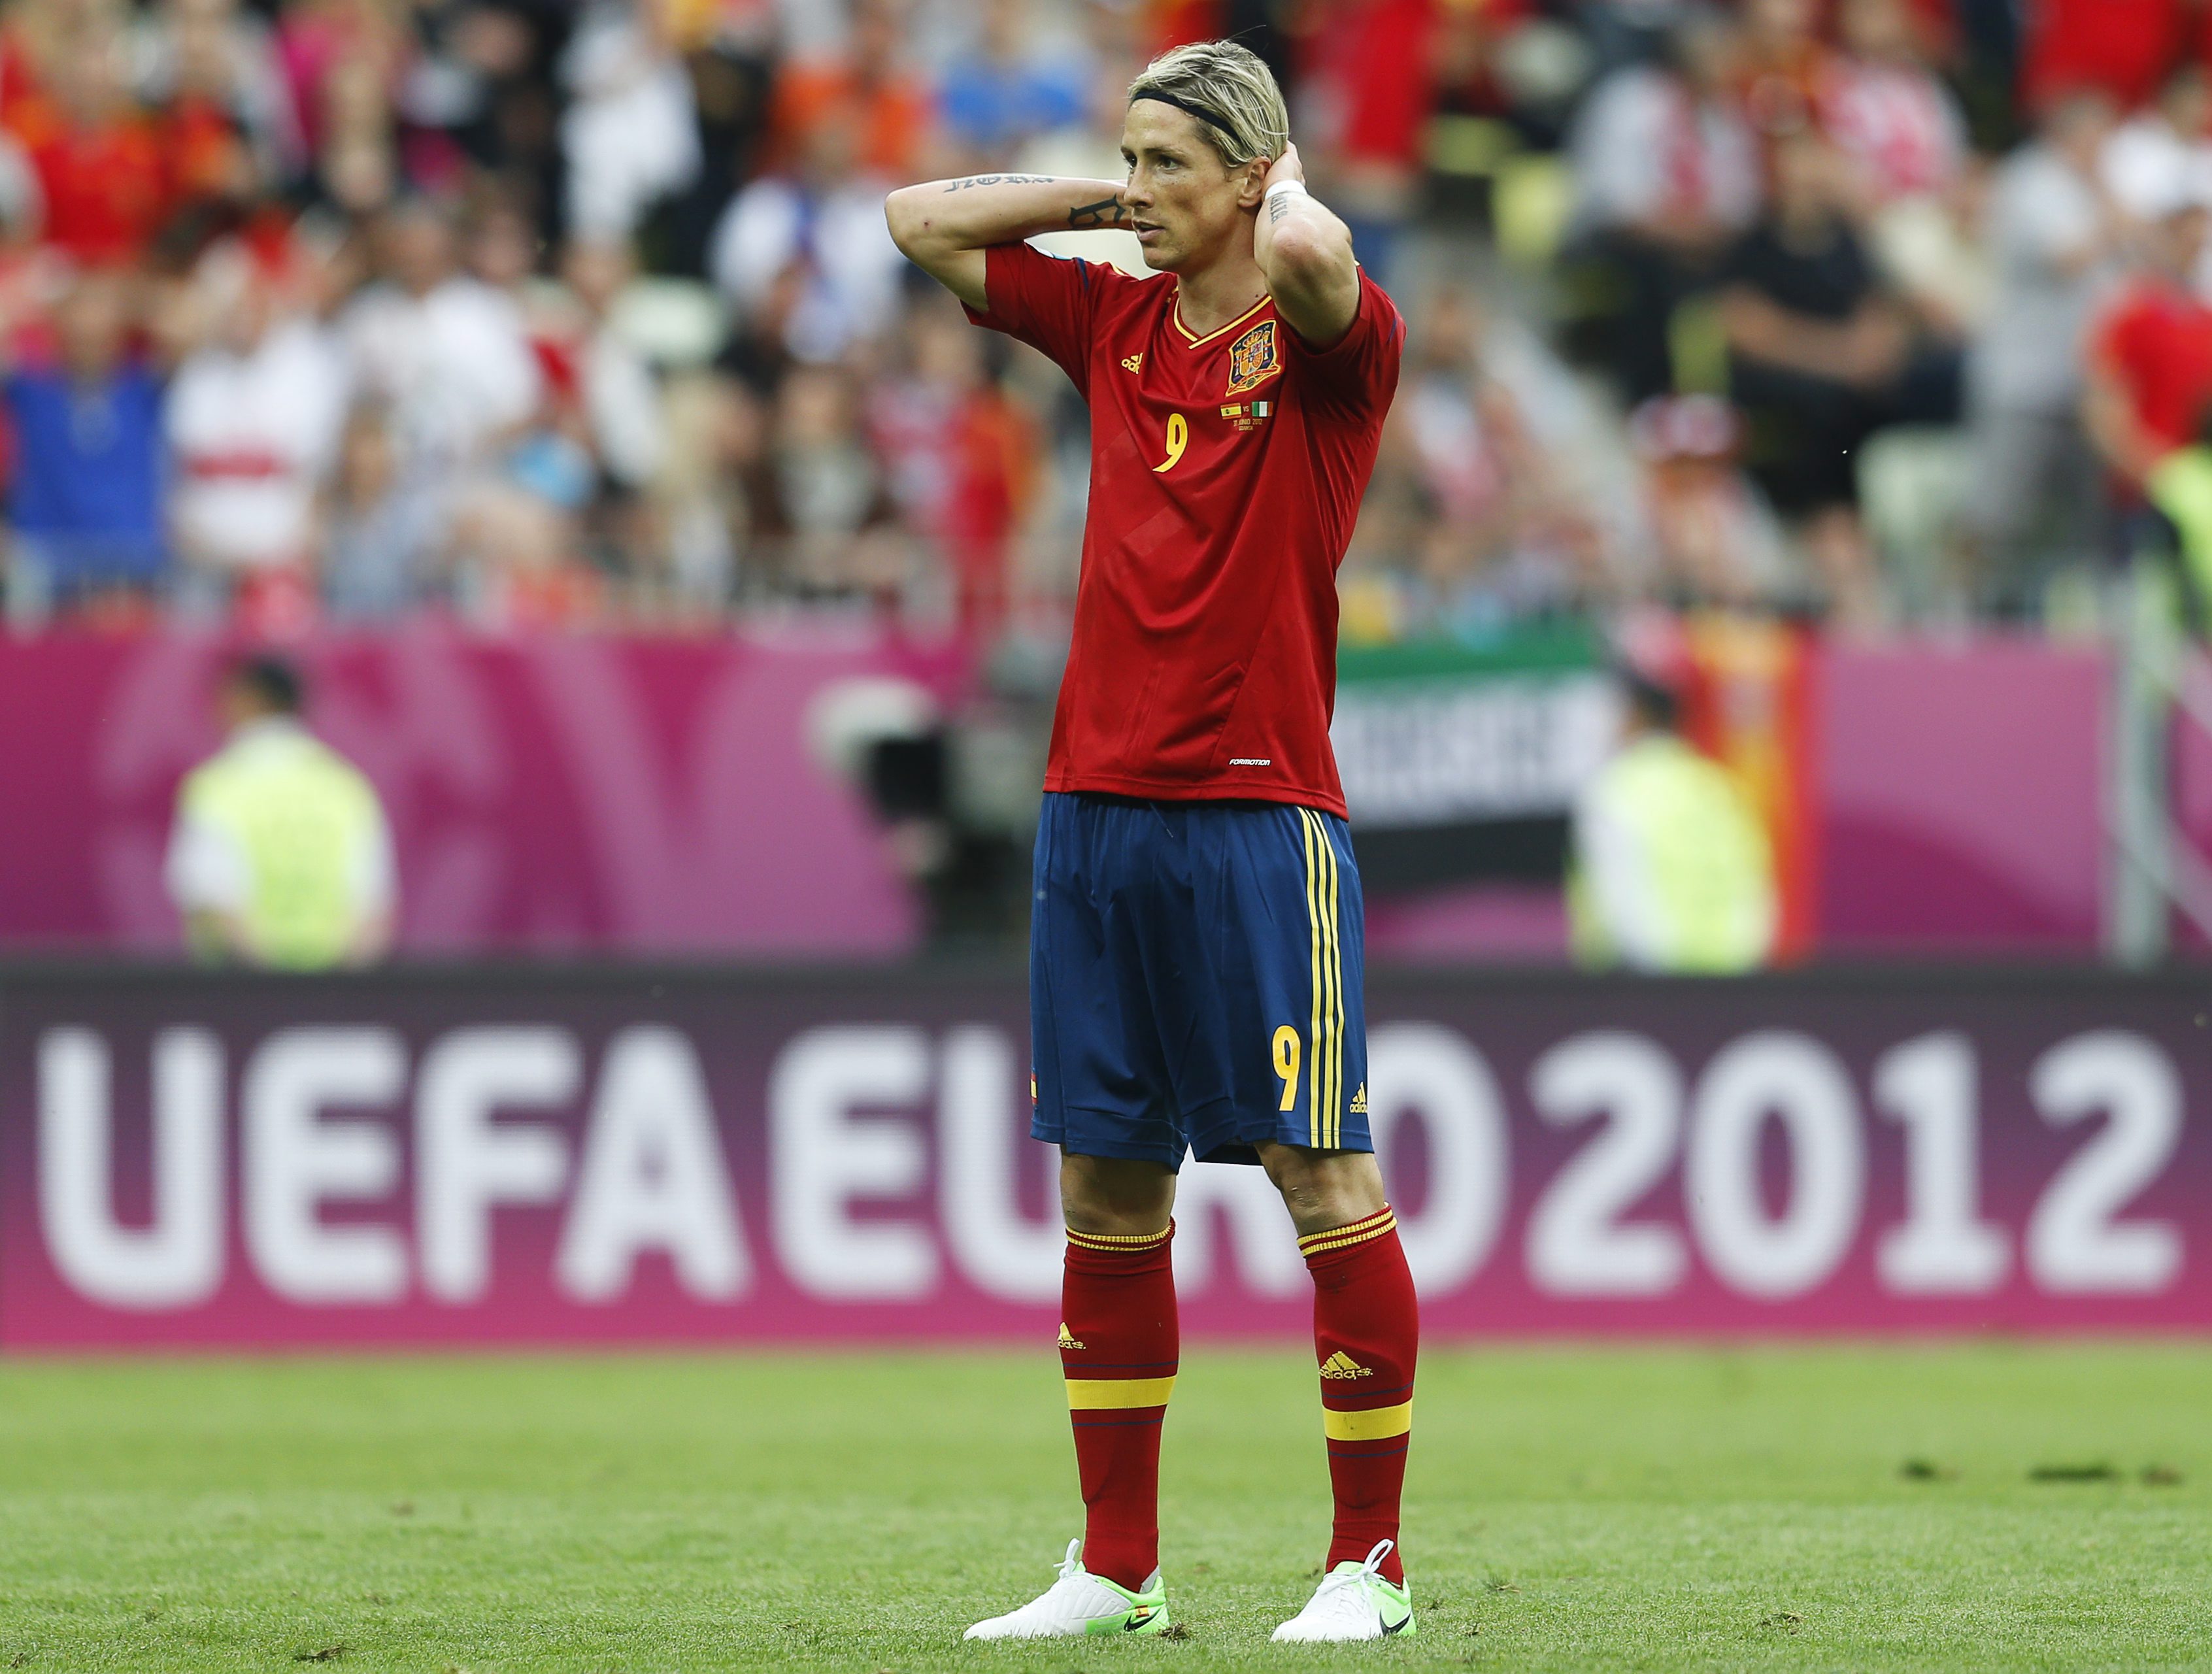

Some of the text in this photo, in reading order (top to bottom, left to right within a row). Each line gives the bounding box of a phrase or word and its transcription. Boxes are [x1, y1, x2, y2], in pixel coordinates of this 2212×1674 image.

[1152, 413, 1188, 473] 9
[1272, 1025, 1301, 1111] 9
[37, 1027, 752, 1307] UEFA
[1525, 1031, 2182, 1297] 2012
